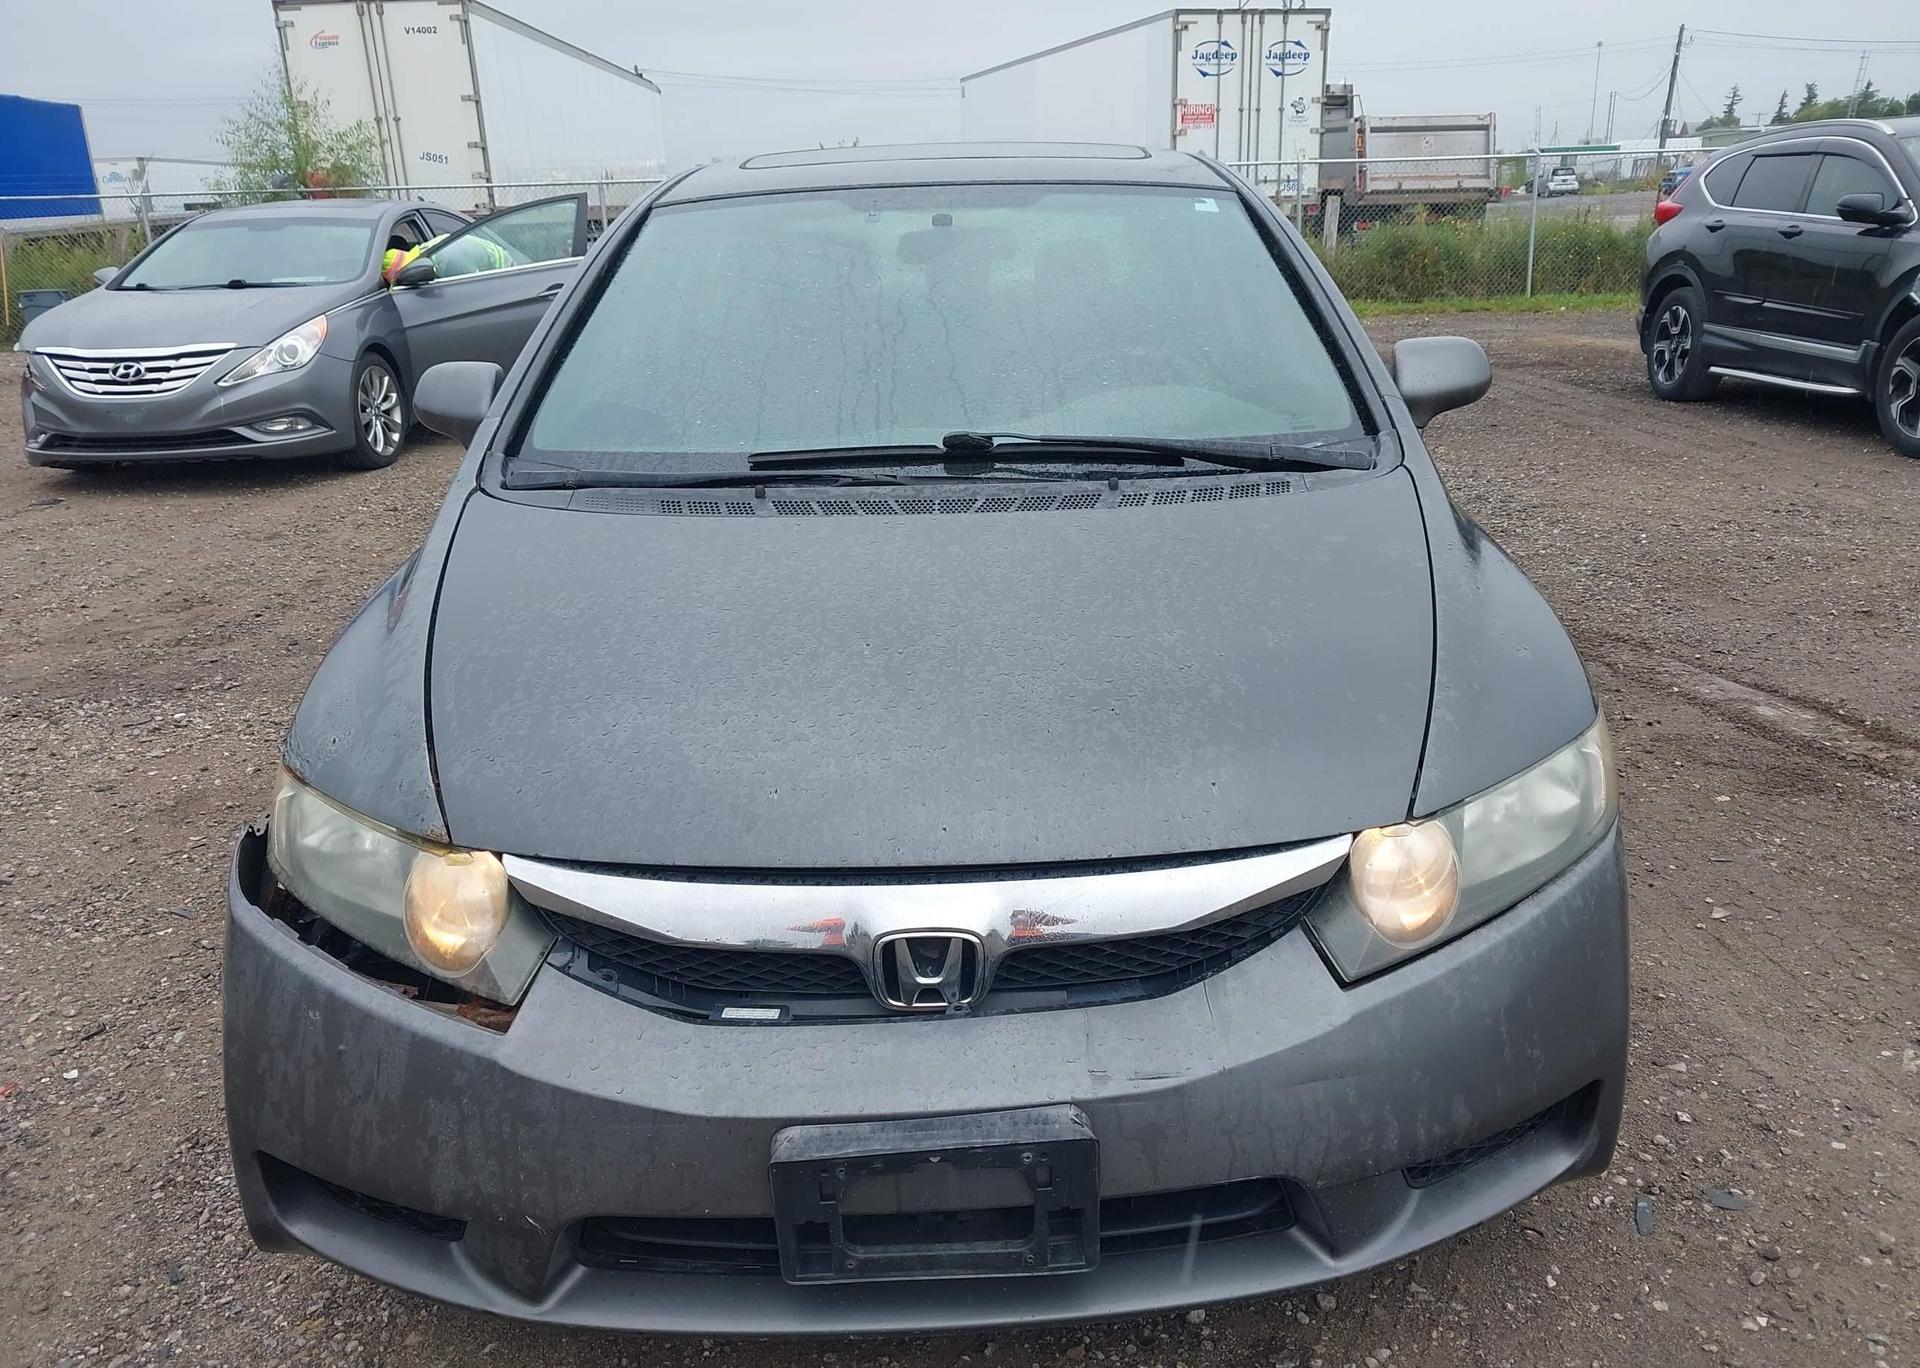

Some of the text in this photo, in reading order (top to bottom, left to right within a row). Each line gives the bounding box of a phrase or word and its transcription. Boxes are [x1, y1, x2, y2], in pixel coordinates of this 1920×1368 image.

[404, 25, 438, 34] V14002
[1191, 50, 1238, 62] Jagdeep
[1265, 50, 1310, 62] Jagdeep
[419, 151, 448, 164] JS051
